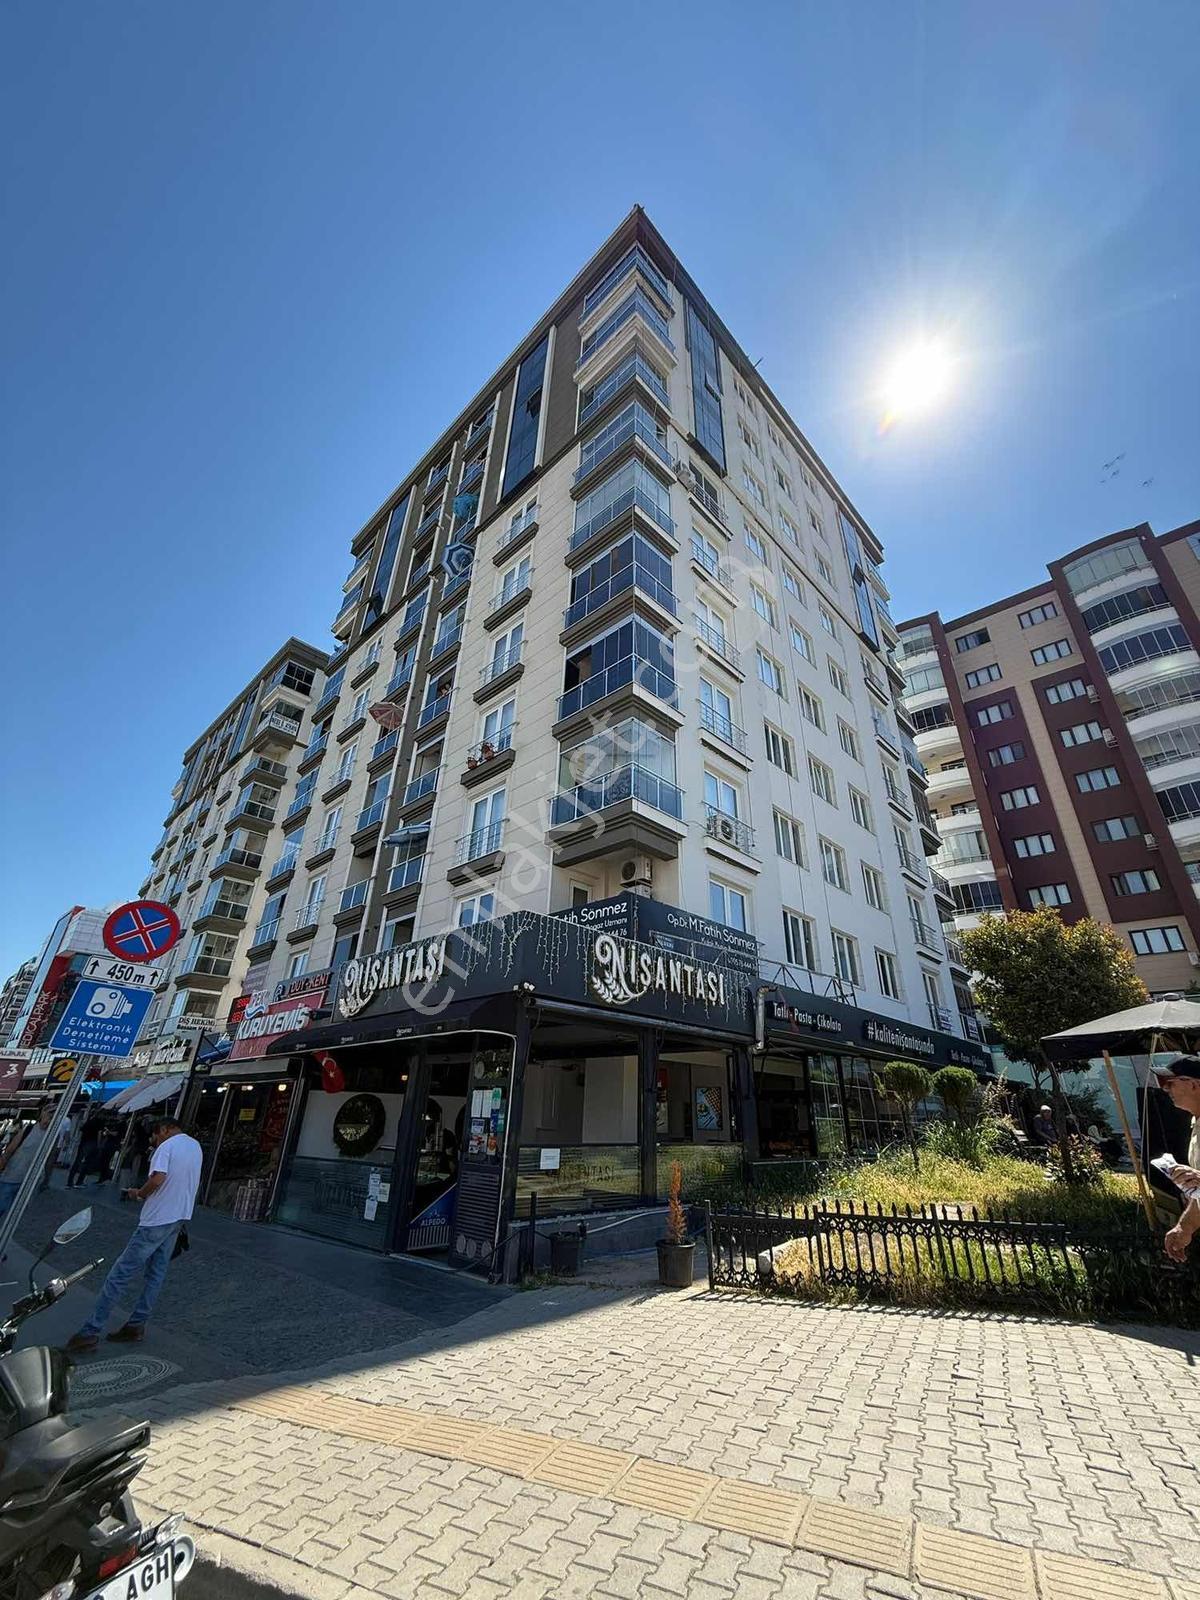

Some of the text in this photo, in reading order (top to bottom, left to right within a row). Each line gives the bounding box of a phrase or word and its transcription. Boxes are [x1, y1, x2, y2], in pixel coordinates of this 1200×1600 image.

[580, 902, 628, 922] Sönmez
[723, 929, 756, 951] Sönmez
[107, 963, 146, 984] 450 m
[69, 1017, 132, 1034] Elektronik
[235, 1003, 312, 1040] KURUYEMİŞ
[794, 1008, 812, 1024] Pasta
[816, 1014, 841, 1032] Çikolata
[62, 1026, 130, 1044] Denetleme
[68, 1038, 116, 1052] Sistemi
[126, 1551, 169, 1600] AGH
